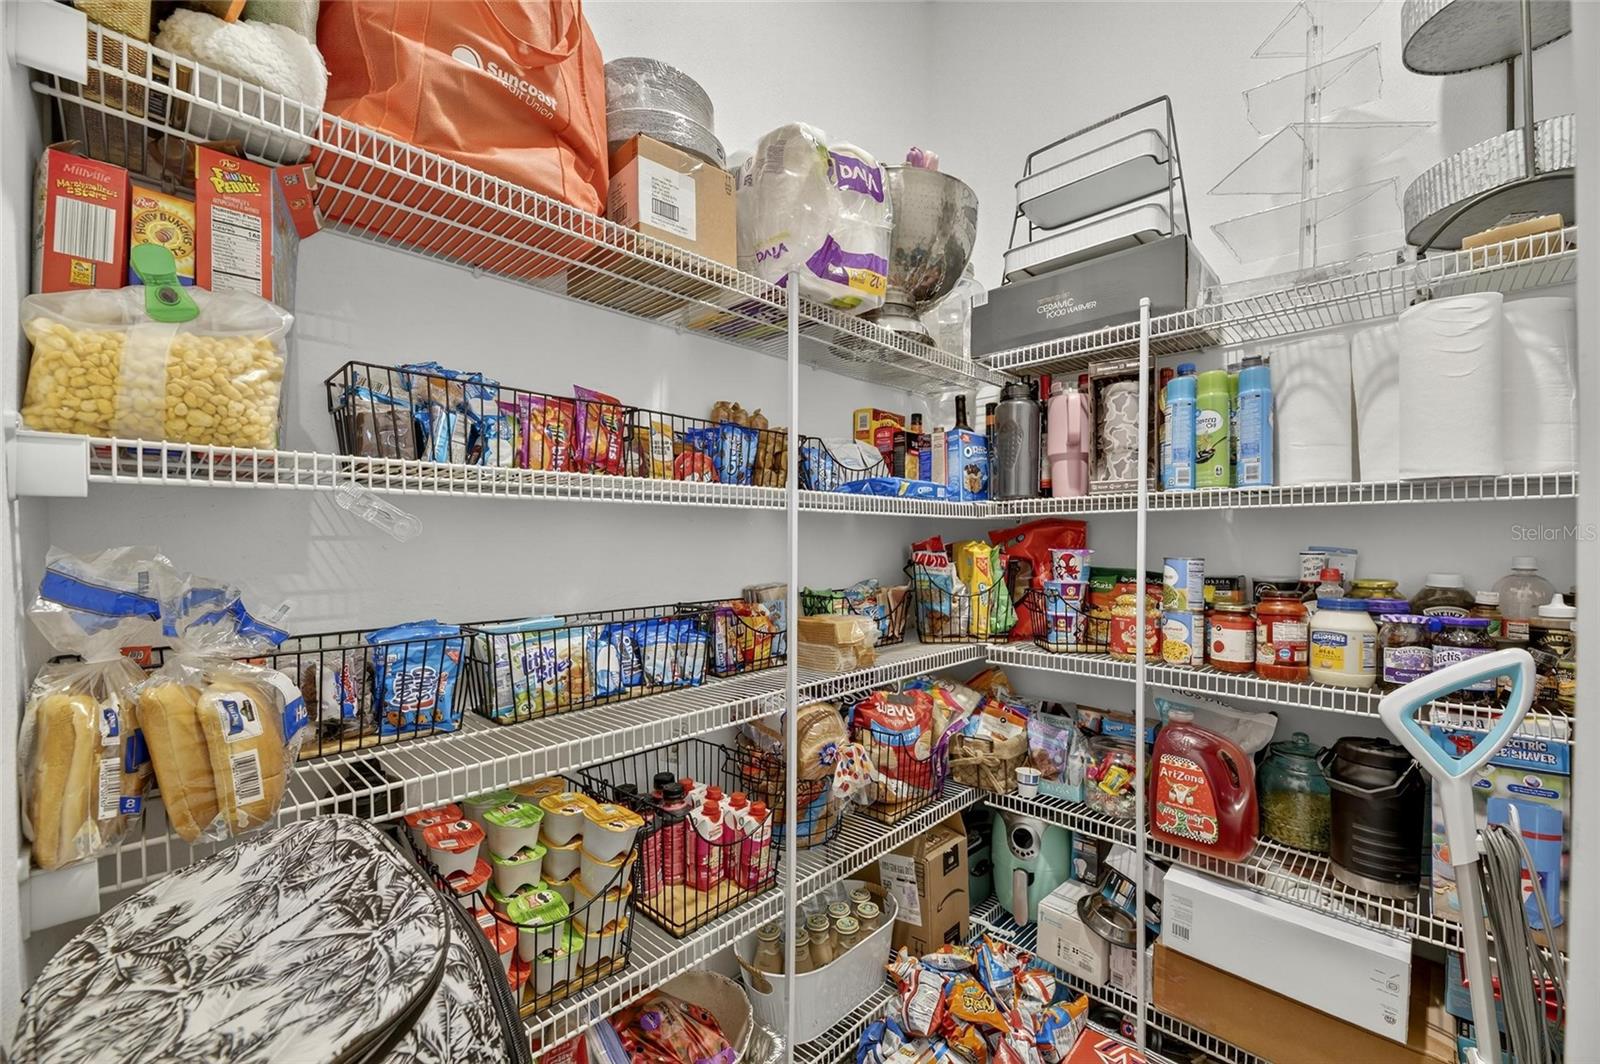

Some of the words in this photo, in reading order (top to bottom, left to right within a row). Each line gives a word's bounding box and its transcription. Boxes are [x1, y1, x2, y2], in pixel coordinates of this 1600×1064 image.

[487, 61, 559, 111] Suncoast
[524, 93, 555, 120] Union
[63, 163, 112, 184] Millville
[211, 167, 254, 183] FRUITY
[210, 177, 261, 195] PEBBLES
[135, 196, 158, 209] Post
[136, 211, 158, 236] HONEY
[159, 211, 193, 247] BUNCHES
[1036, 297, 1074, 314] CERAMIC
[1046, 308, 1067, 319] FOOD
[1066, 300, 1097, 314] WARMER
[521, 646, 556, 676] Little
[535, 657, 573, 684] Bites
[1506, 739, 1548, 752] ECTRIC
[1511, 749, 1557, 765] SHAVER
[125, 798, 136, 809] 8
